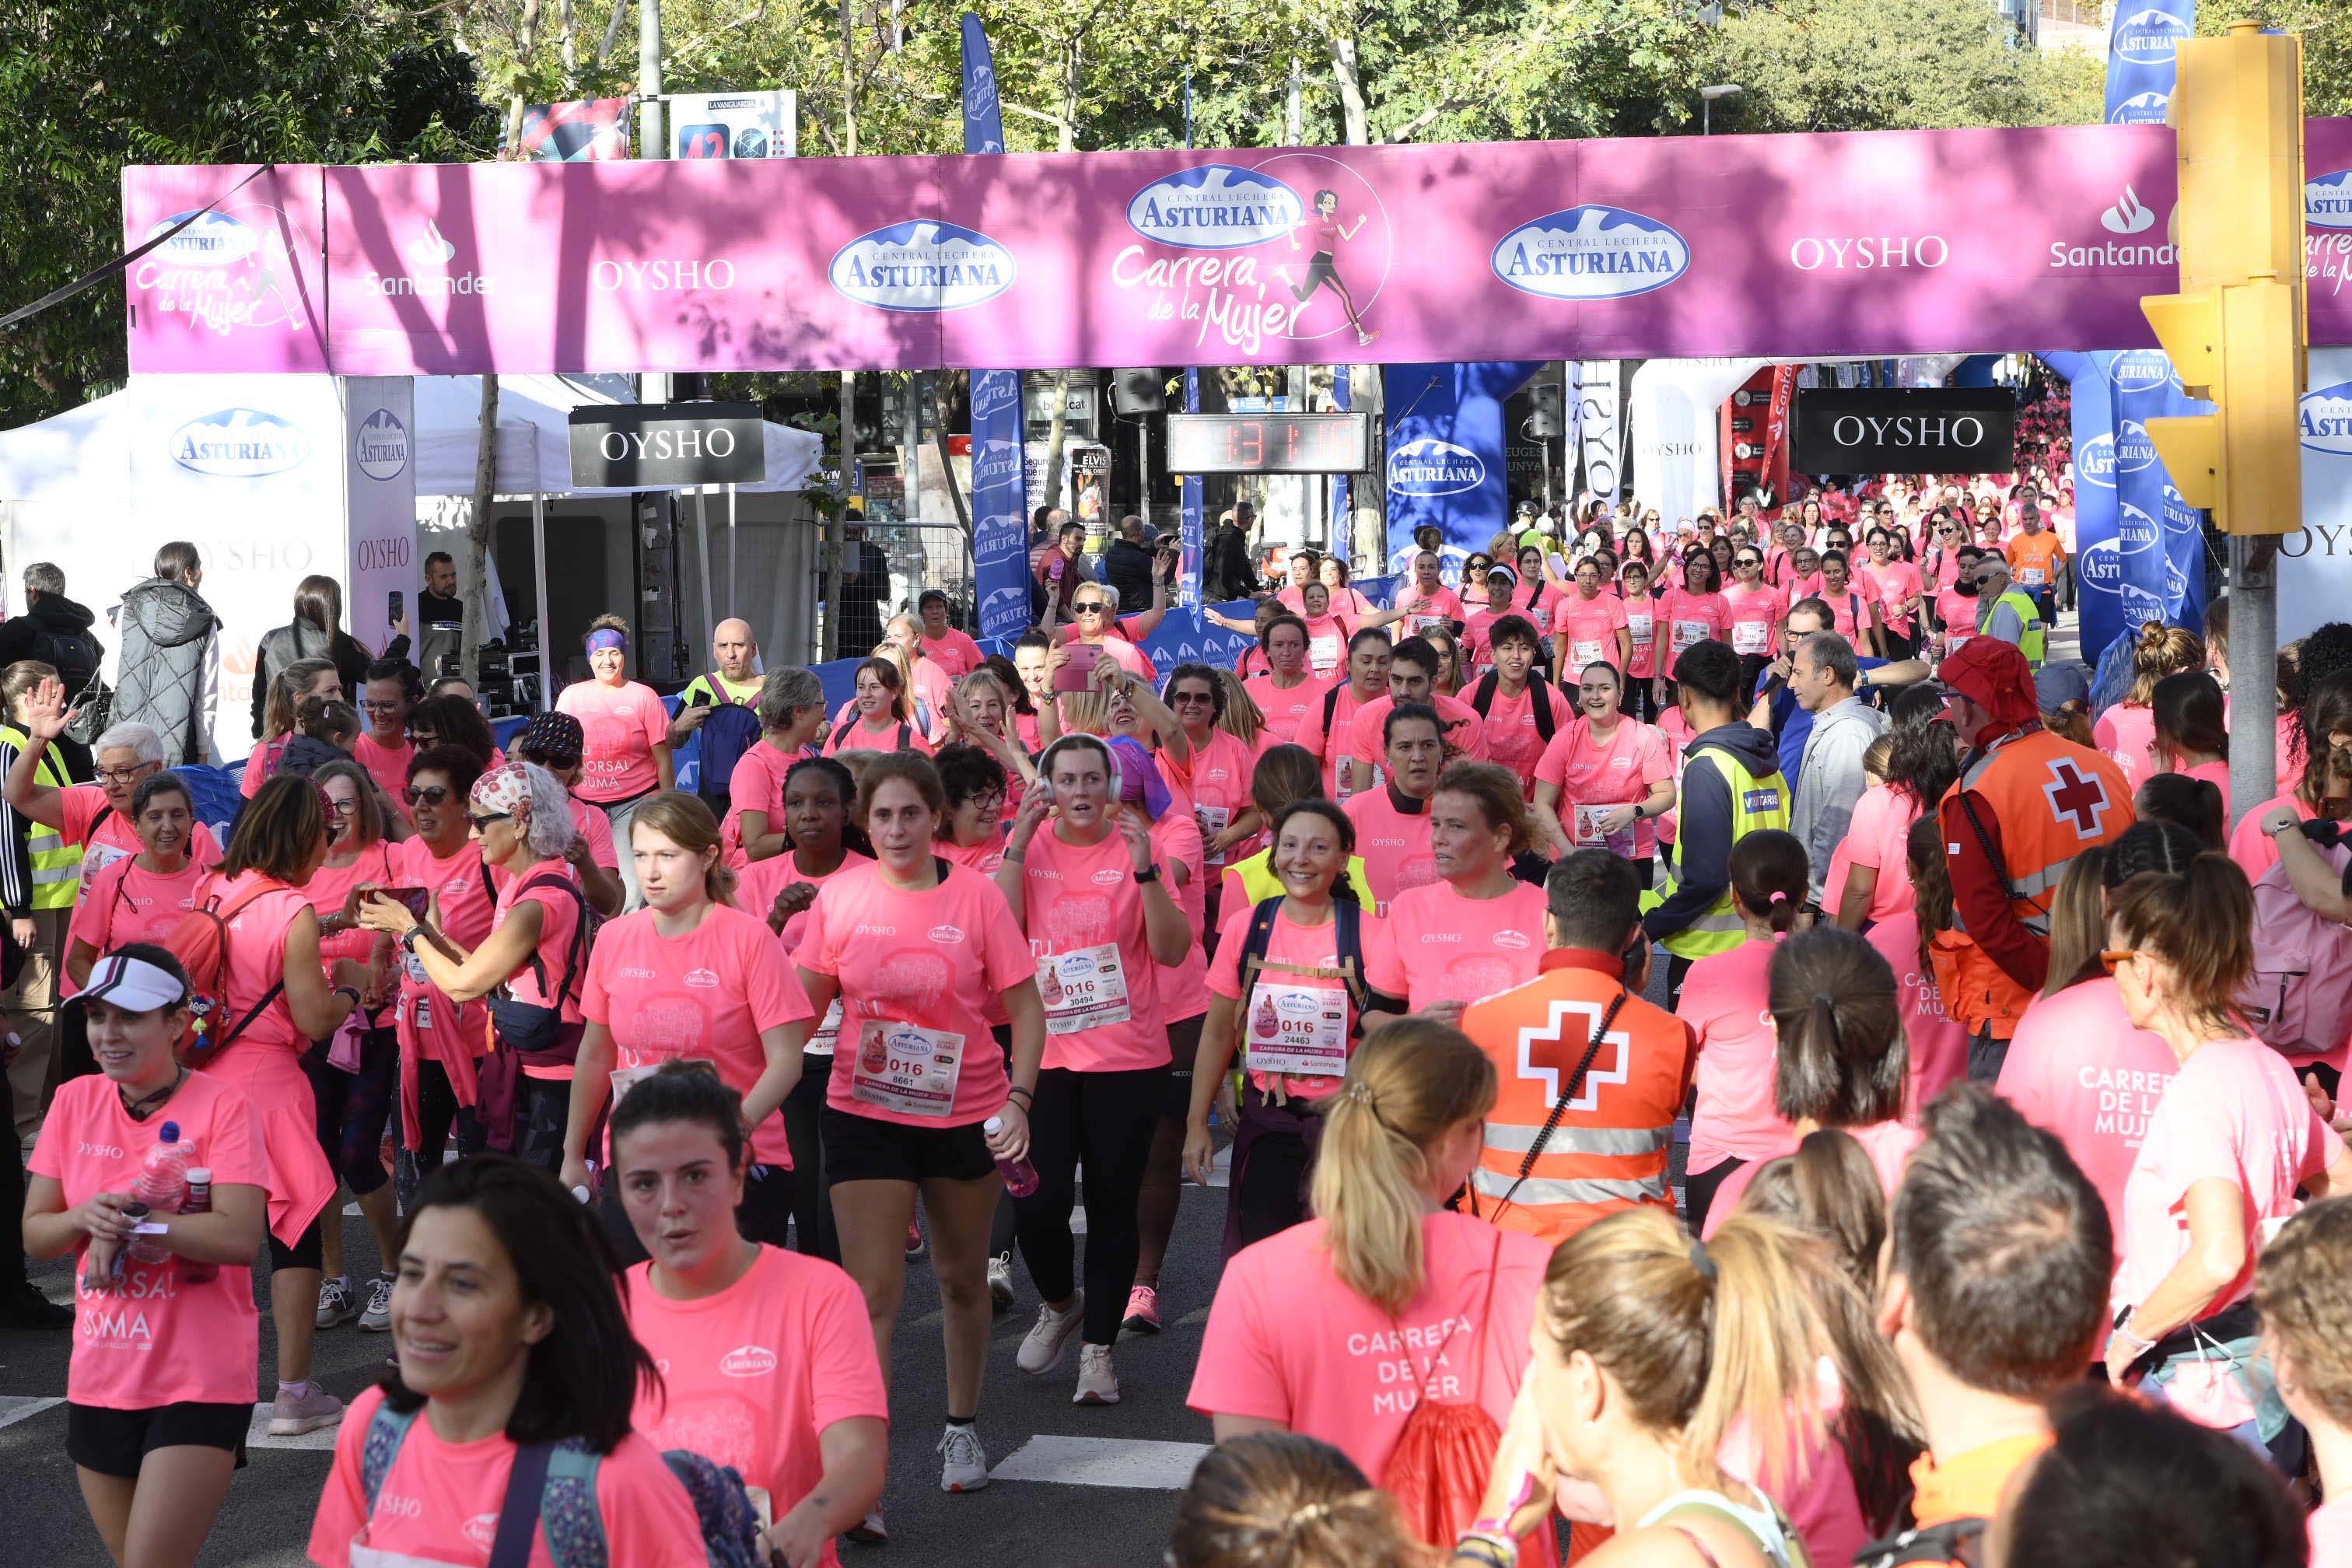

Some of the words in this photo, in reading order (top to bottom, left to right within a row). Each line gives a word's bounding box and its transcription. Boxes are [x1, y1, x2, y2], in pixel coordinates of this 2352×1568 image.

[2120, 31, 2184, 51] ASTURIAN
[1167, 194, 1223, 203] CENTRAL
[1140, 196, 1290, 228] ASTURIANA
[1537, 238, 1599, 249] CENTRAL
[1605, 236, 1668, 247] LECHERA
[873, 250, 930, 261] CENTRAL
[936, 250, 996, 260] LECHERA
[1506, 242, 1675, 276] ASTURIANA
[1790, 235, 1949, 270] OYSHO
[136, 261, 228, 290] Carrera
[592, 259, 736, 291] OYSHO
[846, 254, 1002, 289] ASTURIANA
[1111, 245, 1257, 288] Carrera
[363, 271, 499, 296] Santander
[190, 286, 262, 336] Mujer
[1147, 294, 1173, 320] de
[1180, 289, 1199, 320] la
[1195, 283, 1312, 356] Mujer
[1833, 415, 1983, 447] OYSHO
[359, 439, 405, 463] ASTURIANA
[600, 428, 735, 462] OYSHO
[1643, 443, 1703, 457] OYSHO
[1082, 456, 1108, 466] ELVIS
[1390, 462, 1479, 484] ASTURIANA
[2277, 523, 2352, 558] OY
[358, 537, 409, 572] OYSHO
[582, 775, 620, 788] SUMA
[1372, 838, 1405, 847] OYSHO
[1028, 867, 1064, 881] OYSHO
[856, 923, 896, 936] OYSHO
[1422, 933, 1462, 943] OYSHO
[1029, 939, 1052, 957] TU
[621, 968, 656, 979] OYSHO
[1065, 980, 1095, 996] 016
[1920, 987, 1942, 1000] DE
[1069, 996, 1094, 1006] 30494
[1281, 1000, 1316, 1010] ASTURIANA
[1282, 1020, 1314, 1034] 016
[892, 1038, 929, 1052] ASTURIANA
[1284, 1035, 1311, 1045] 24463
[889, 1059, 923, 1076] 016
[1257, 1057, 1286, 1066] OYSHO
[1310, 1059, 1339, 1069] Santander
[893, 1076, 914, 1087] 8661
[908, 1090, 929, 1098] MUJER
[2100, 1090, 2131, 1113] DE
[83, 1310, 150, 1339] SUMA
[1378, 1360, 1416, 1384] DE
[1374, 1375, 1461, 1415] MUER
